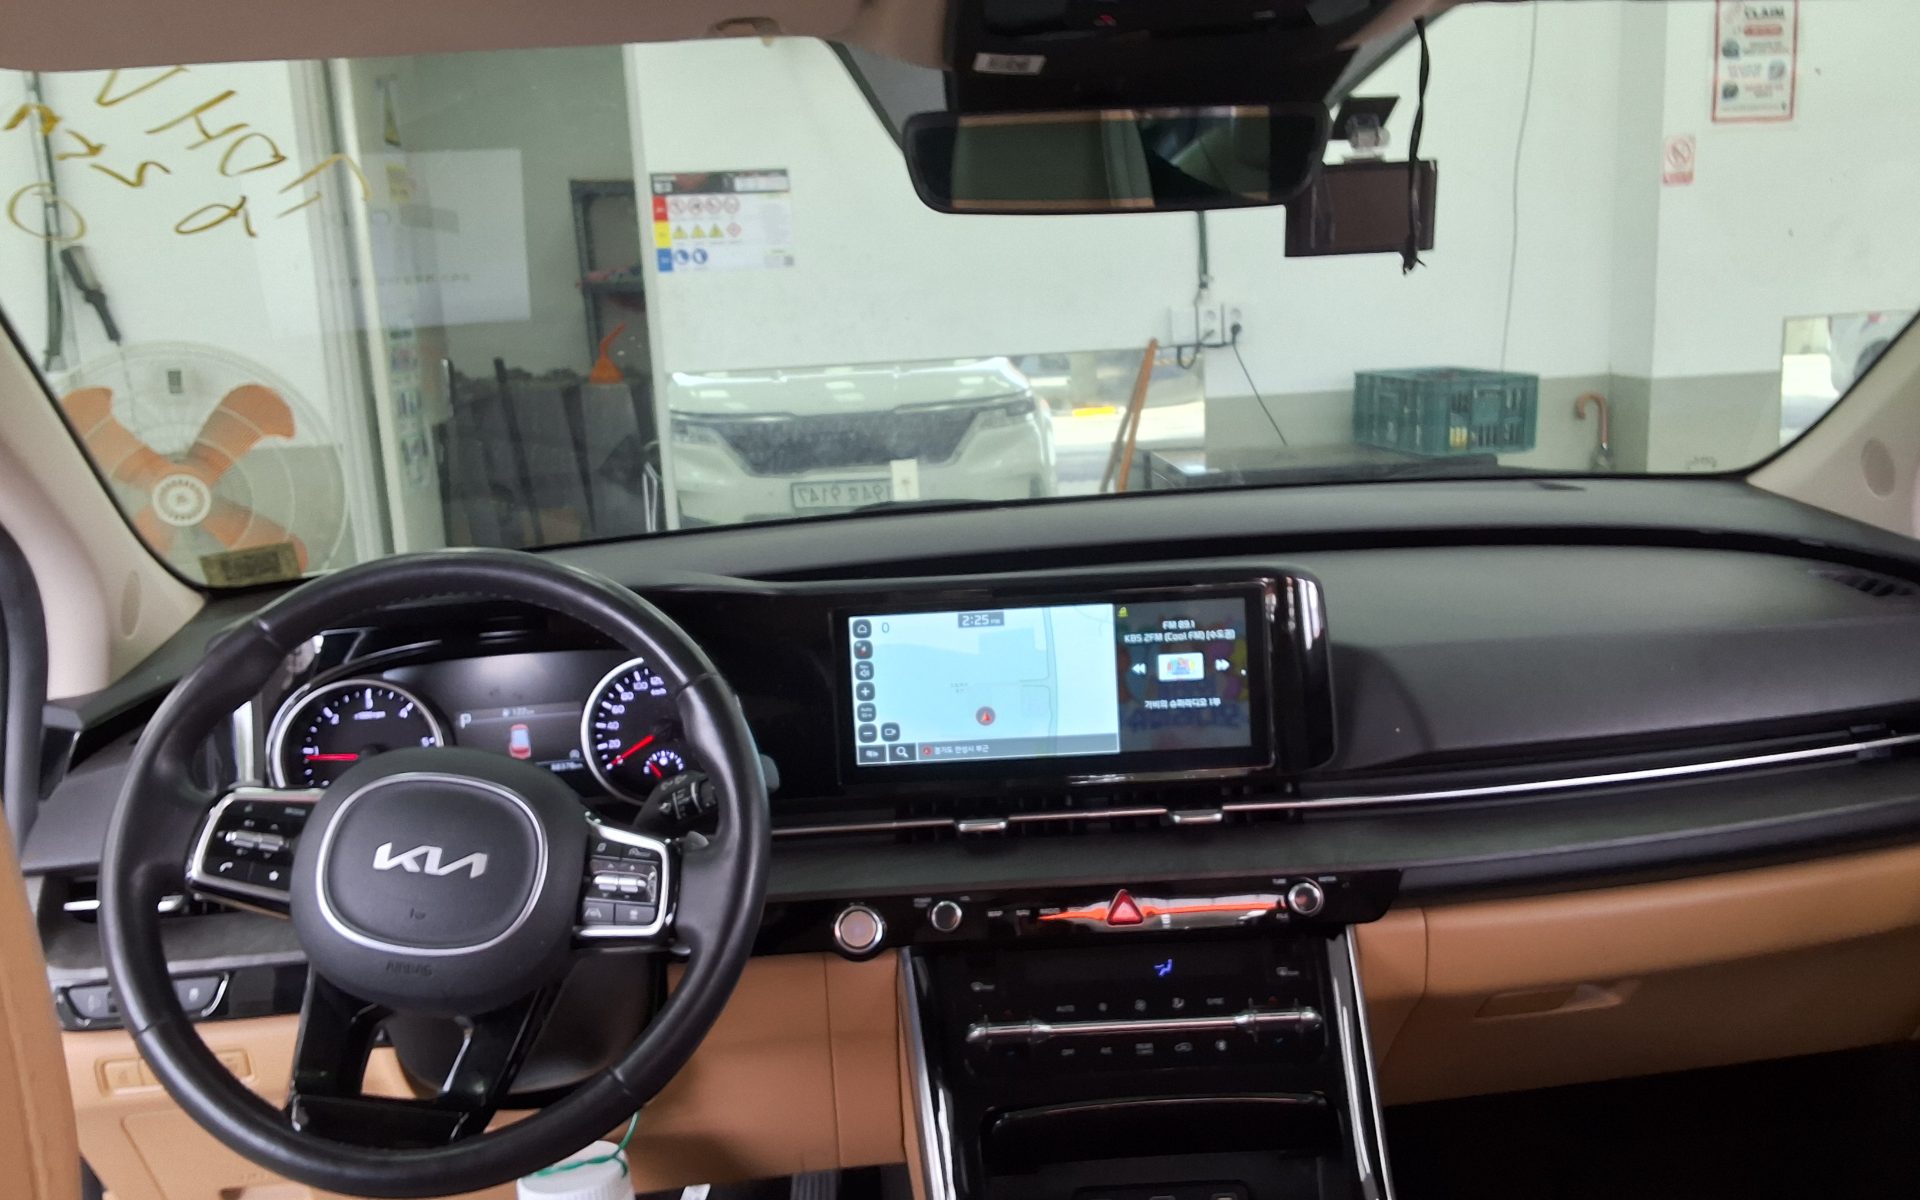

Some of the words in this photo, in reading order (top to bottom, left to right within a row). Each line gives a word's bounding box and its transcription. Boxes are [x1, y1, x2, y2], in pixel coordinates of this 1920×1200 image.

[962, 614, 990, 627] 2:25
[1162, 620, 1177, 630] FM
[1178, 619, 1196, 629] 89.1
[1124, 633, 1143, 644] KBS
[1144, 632, 1163, 643] 2FM
[633, 681, 648, 691] 100
[460, 713, 472, 729] P
[372, 842, 488, 879] KIA
